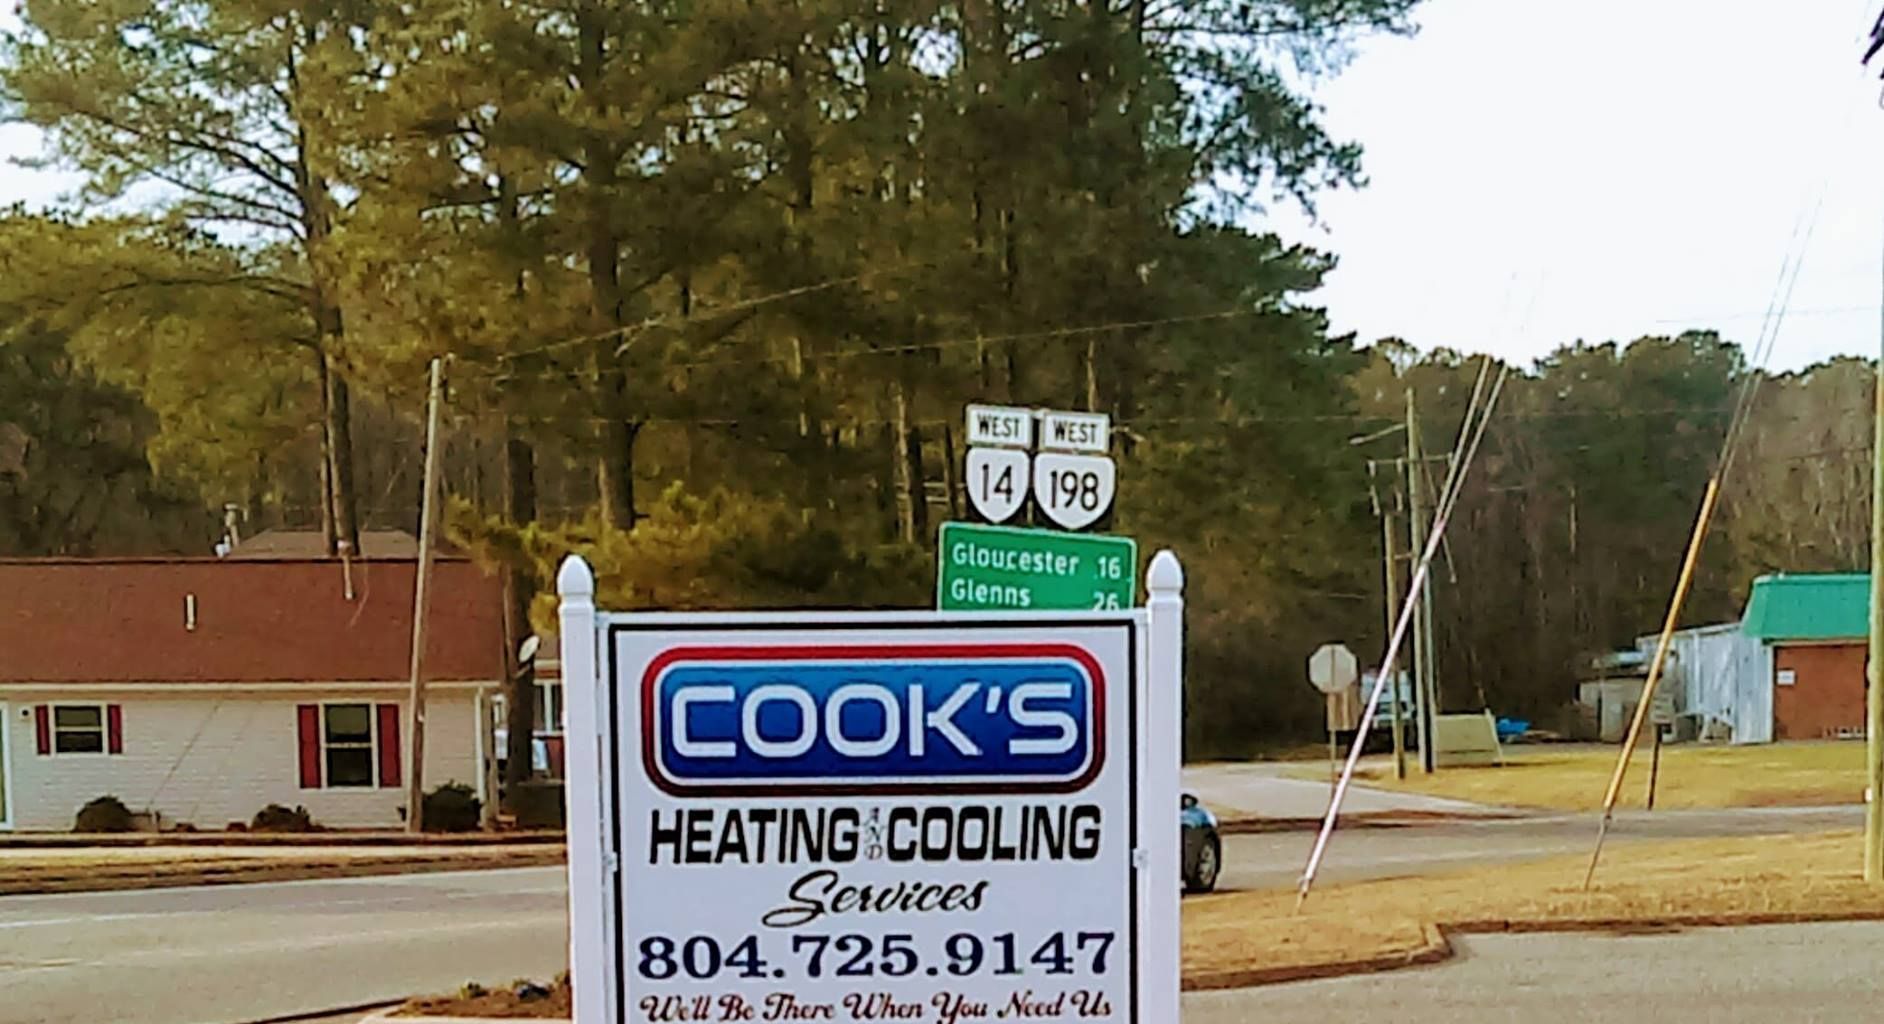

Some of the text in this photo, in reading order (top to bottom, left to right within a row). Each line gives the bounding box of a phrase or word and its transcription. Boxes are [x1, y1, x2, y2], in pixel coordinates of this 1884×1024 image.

[977, 413, 1020, 438] WEST
[1053, 420, 1098, 443] WEST
[982, 463, 1013, 504] 14
[1050, 470, 1099, 511] 198
[952, 543, 1121, 580] Gloucester 16
[951, 578, 1032, 607] Glenns
[671, 682, 1079, 758] COOK'S
[650, 807, 860, 864] HEATING
[887, 804, 1101, 862] COOLING
[762, 869, 989, 927] Services
[638, 932, 1115, 980] 804.725.9147
[640, 993, 712, 1023] We'll
[718, 993, 755, 1020] Be
[763, 992, 835, 1021] There
[844, 991, 923, 1020] When
[997, 989, 1066, 1020] Need
[1071, 990, 1112, 1018] Us
